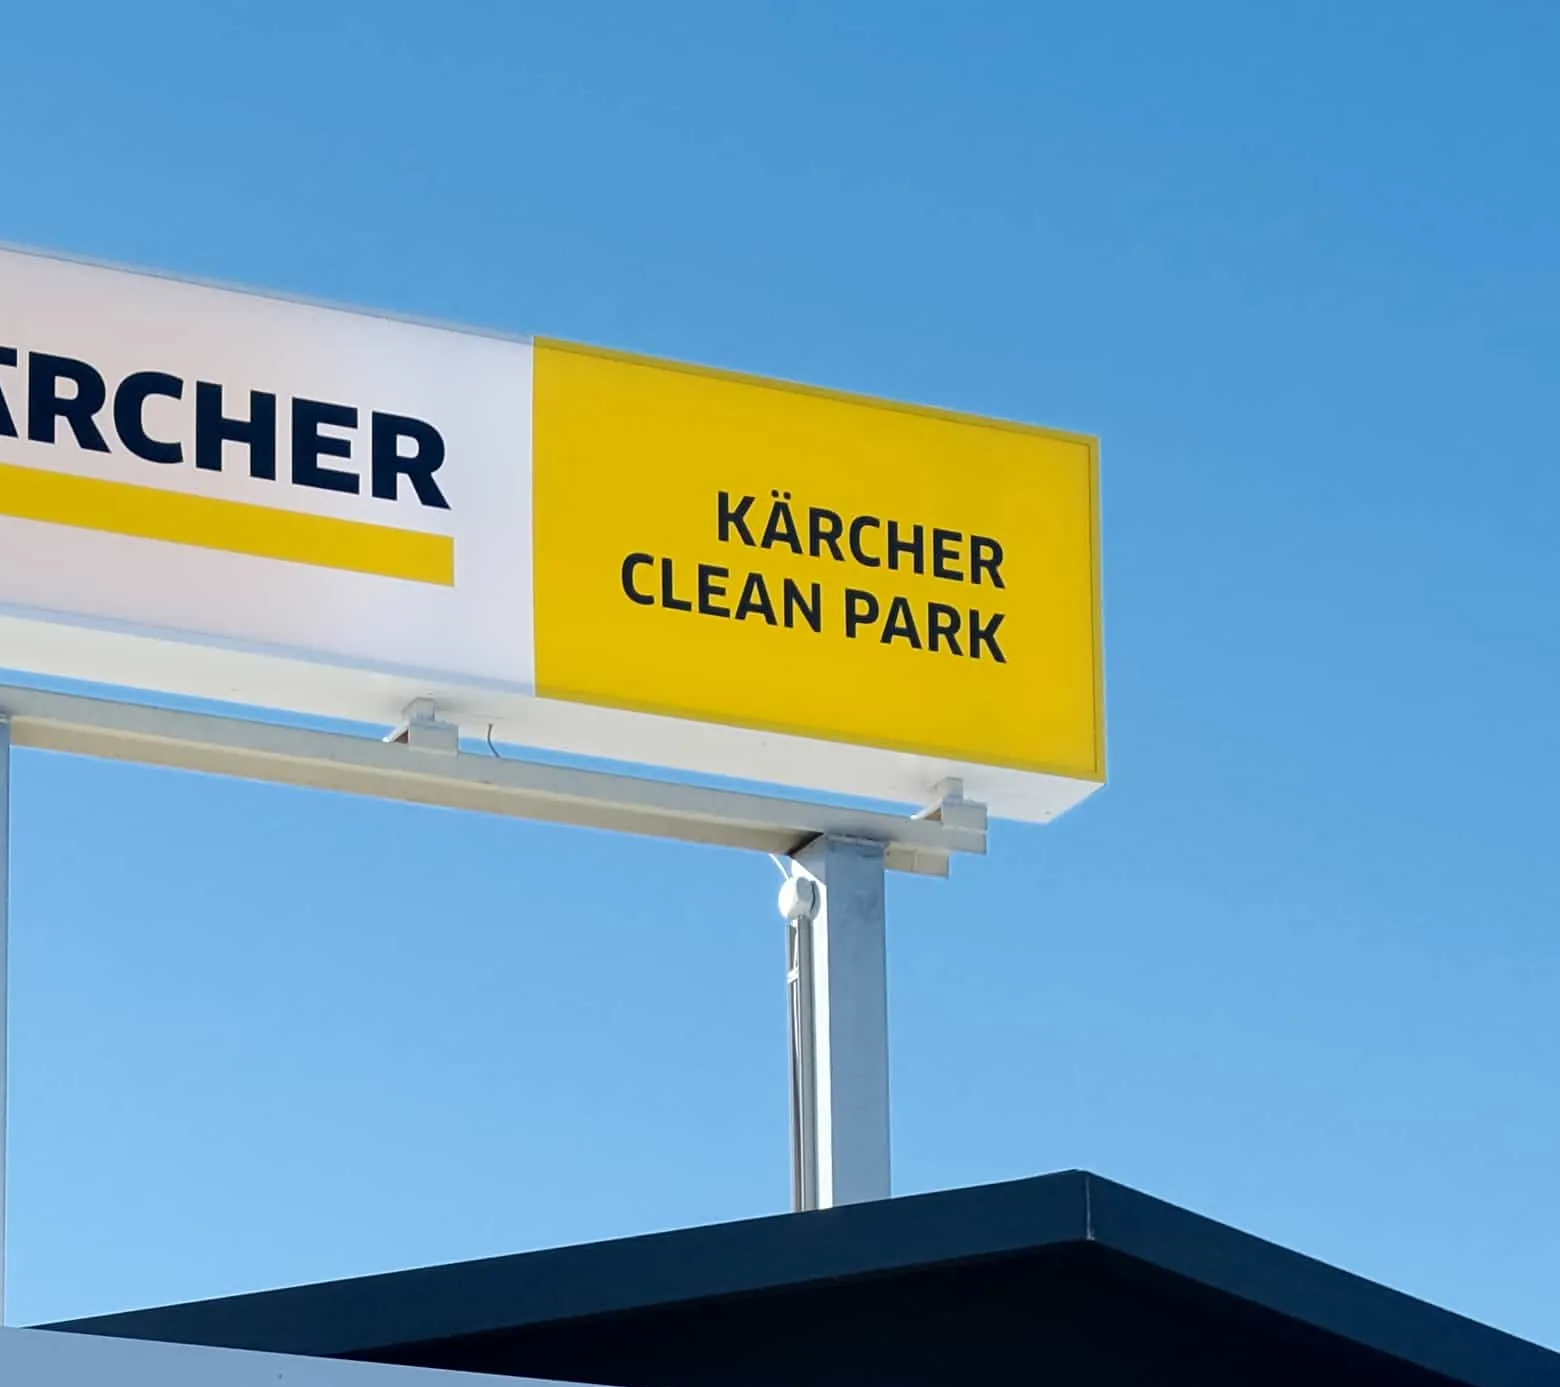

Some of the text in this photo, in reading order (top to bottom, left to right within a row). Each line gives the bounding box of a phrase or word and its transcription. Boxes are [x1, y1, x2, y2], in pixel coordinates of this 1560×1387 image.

[717, 489, 1006, 589] KÄRCHER
[621, 552, 1007, 664] CLEAN PARK
